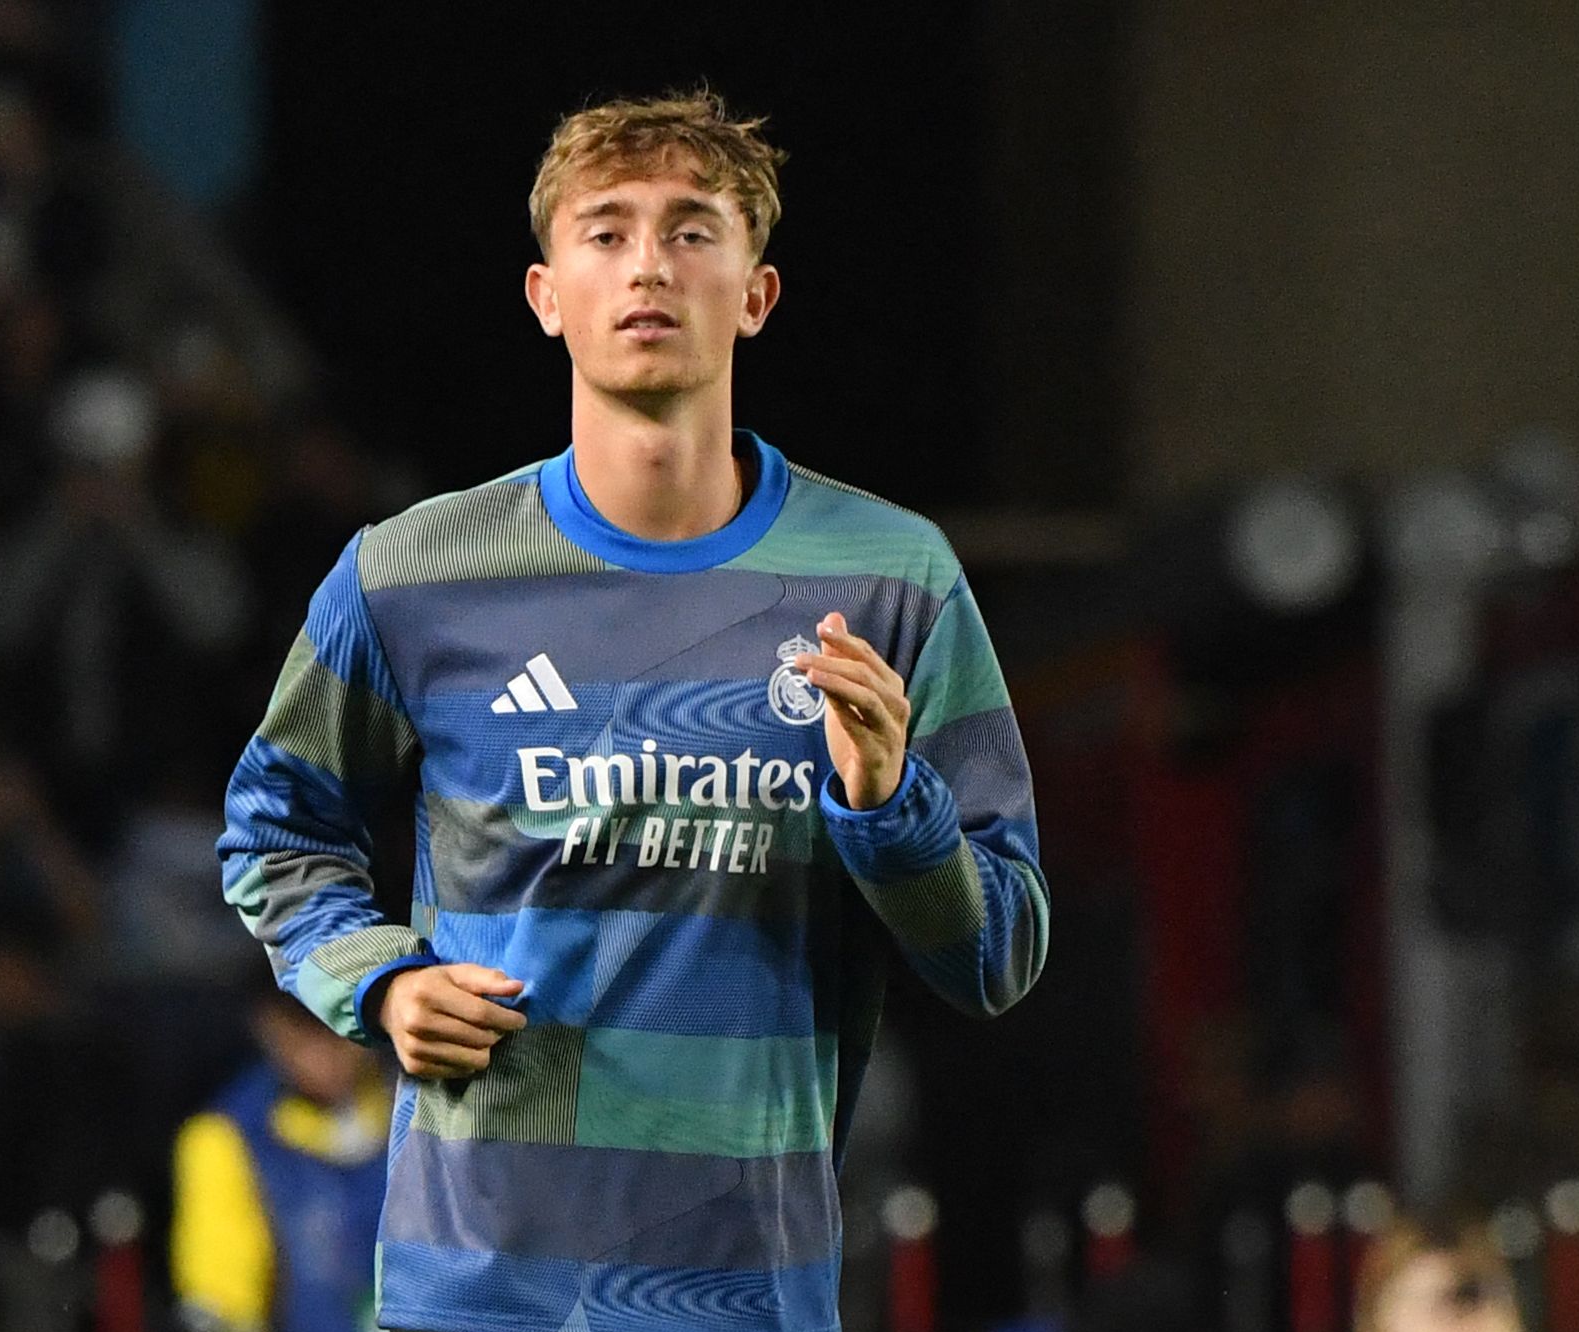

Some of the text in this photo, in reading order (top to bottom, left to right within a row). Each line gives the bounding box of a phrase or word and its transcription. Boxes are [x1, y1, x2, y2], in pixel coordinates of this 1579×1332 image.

[516, 739, 814, 812] Emirates
[560, 817, 773, 874] FLY BETTER
